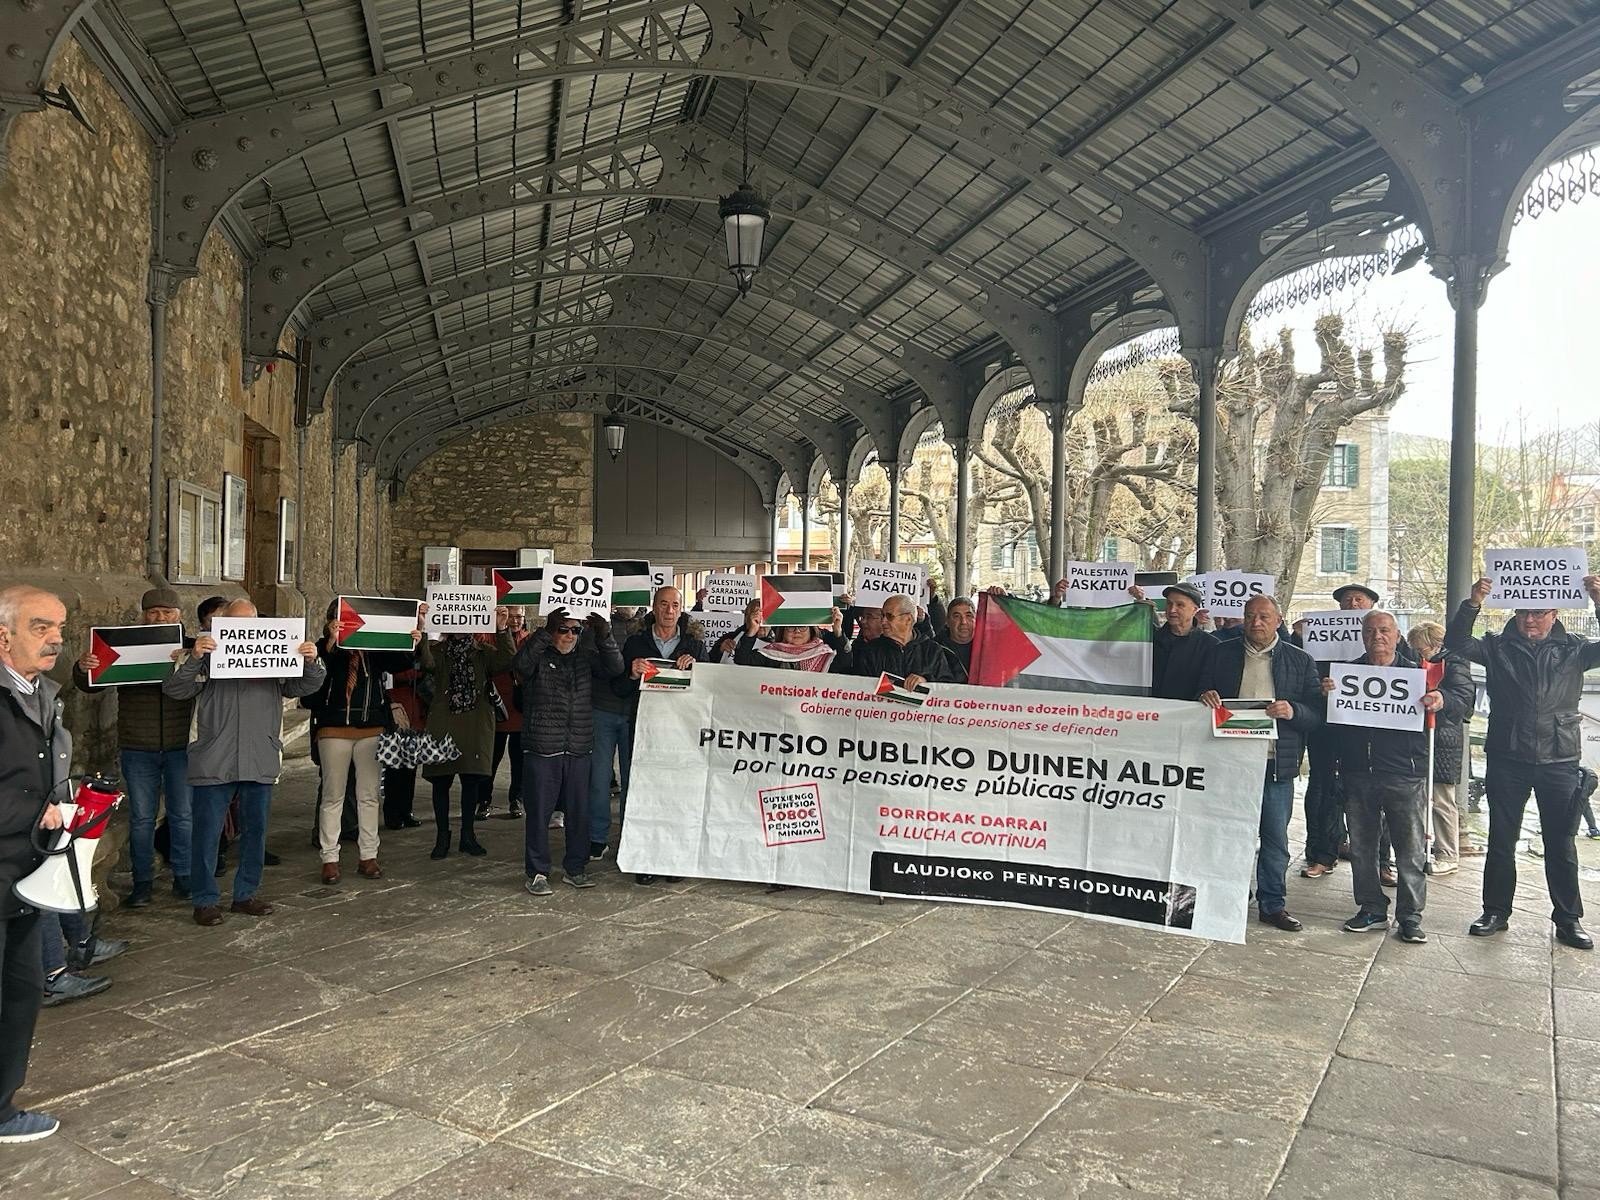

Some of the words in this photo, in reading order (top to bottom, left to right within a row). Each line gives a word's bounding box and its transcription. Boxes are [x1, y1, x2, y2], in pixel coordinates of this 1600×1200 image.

[1494, 559, 1567, 571] PAREMOS
[863, 567, 917, 581] PALESTINA
[1071, 567, 1128, 577] PALESTINA
[552, 574, 604, 597] SOS
[1071, 579, 1127, 591] ASKATU
[1500, 575, 1570, 586] MASACRE
[711, 588, 750, 596] SARRASKIA
[861, 579, 916, 596] ASKATU
[1214, 579, 1263, 598] SOS
[1503, 589, 1582, 599] PALESTINA
[547, 595, 607, 608] PALESTINA
[708, 595, 752, 606] GELDITU
[436, 604, 488, 612] SARRASKIA
[431, 614, 491, 626] GELDITU
[700, 619, 732, 629] REMOS
[1307, 617, 1363, 626] PALESTIN
[220, 629, 287, 640] PAREMOS
[1307, 629, 1362, 642] ASKAT
[225, 644, 288, 655] MASACRE
[228, 657, 298, 668] PALESTINA
[1340, 674, 1410, 701] SOS
[760, 684, 818, 698] Pentsioak
[926, 696, 950, 708] dira
[953, 700, 1023, 713] Gobernuan
[1027, 703, 1079, 717] edozein
[1082, 705, 1133, 722] badago
[1136, 712, 1160, 722] ere
[1336, 698, 1418, 716] PALESTINA
[800, 702, 851, 717] Gobierne
[855, 706, 887, 720] quien
[890, 708, 943, 724] gobierne
[947, 713, 965, 726] las
[967, 715, 1032, 730] pensiones
[1034, 723, 1048, 732] se
[1052, 722, 1118, 737] defienden
[699, 728, 828, 756] PENTSIO
[838, 738, 975, 769] PUBLIKO
[988, 749, 1108, 781] DUINEN
[1117, 759, 1206, 791] ALDE
[732, 758, 776, 775] por
[782, 761, 837, 780] unas
[842, 768, 967, 793] pensiones
[975, 775, 1077, 801] públicas
[1082, 782, 1165, 810] dignas
[763, 792, 814, 804] GUTXIENGO
[772, 800, 815, 810] PENTSIOA
[766, 808, 817, 822] 1080€
[879, 806, 976, 825] BORROKAK
[981, 815, 1047, 832] DARRAI
[879, 824, 899, 837] LA
[903, 826, 956, 842] LUCHA
[1002, 870, 1171, 904] PENTSIODUNAK
